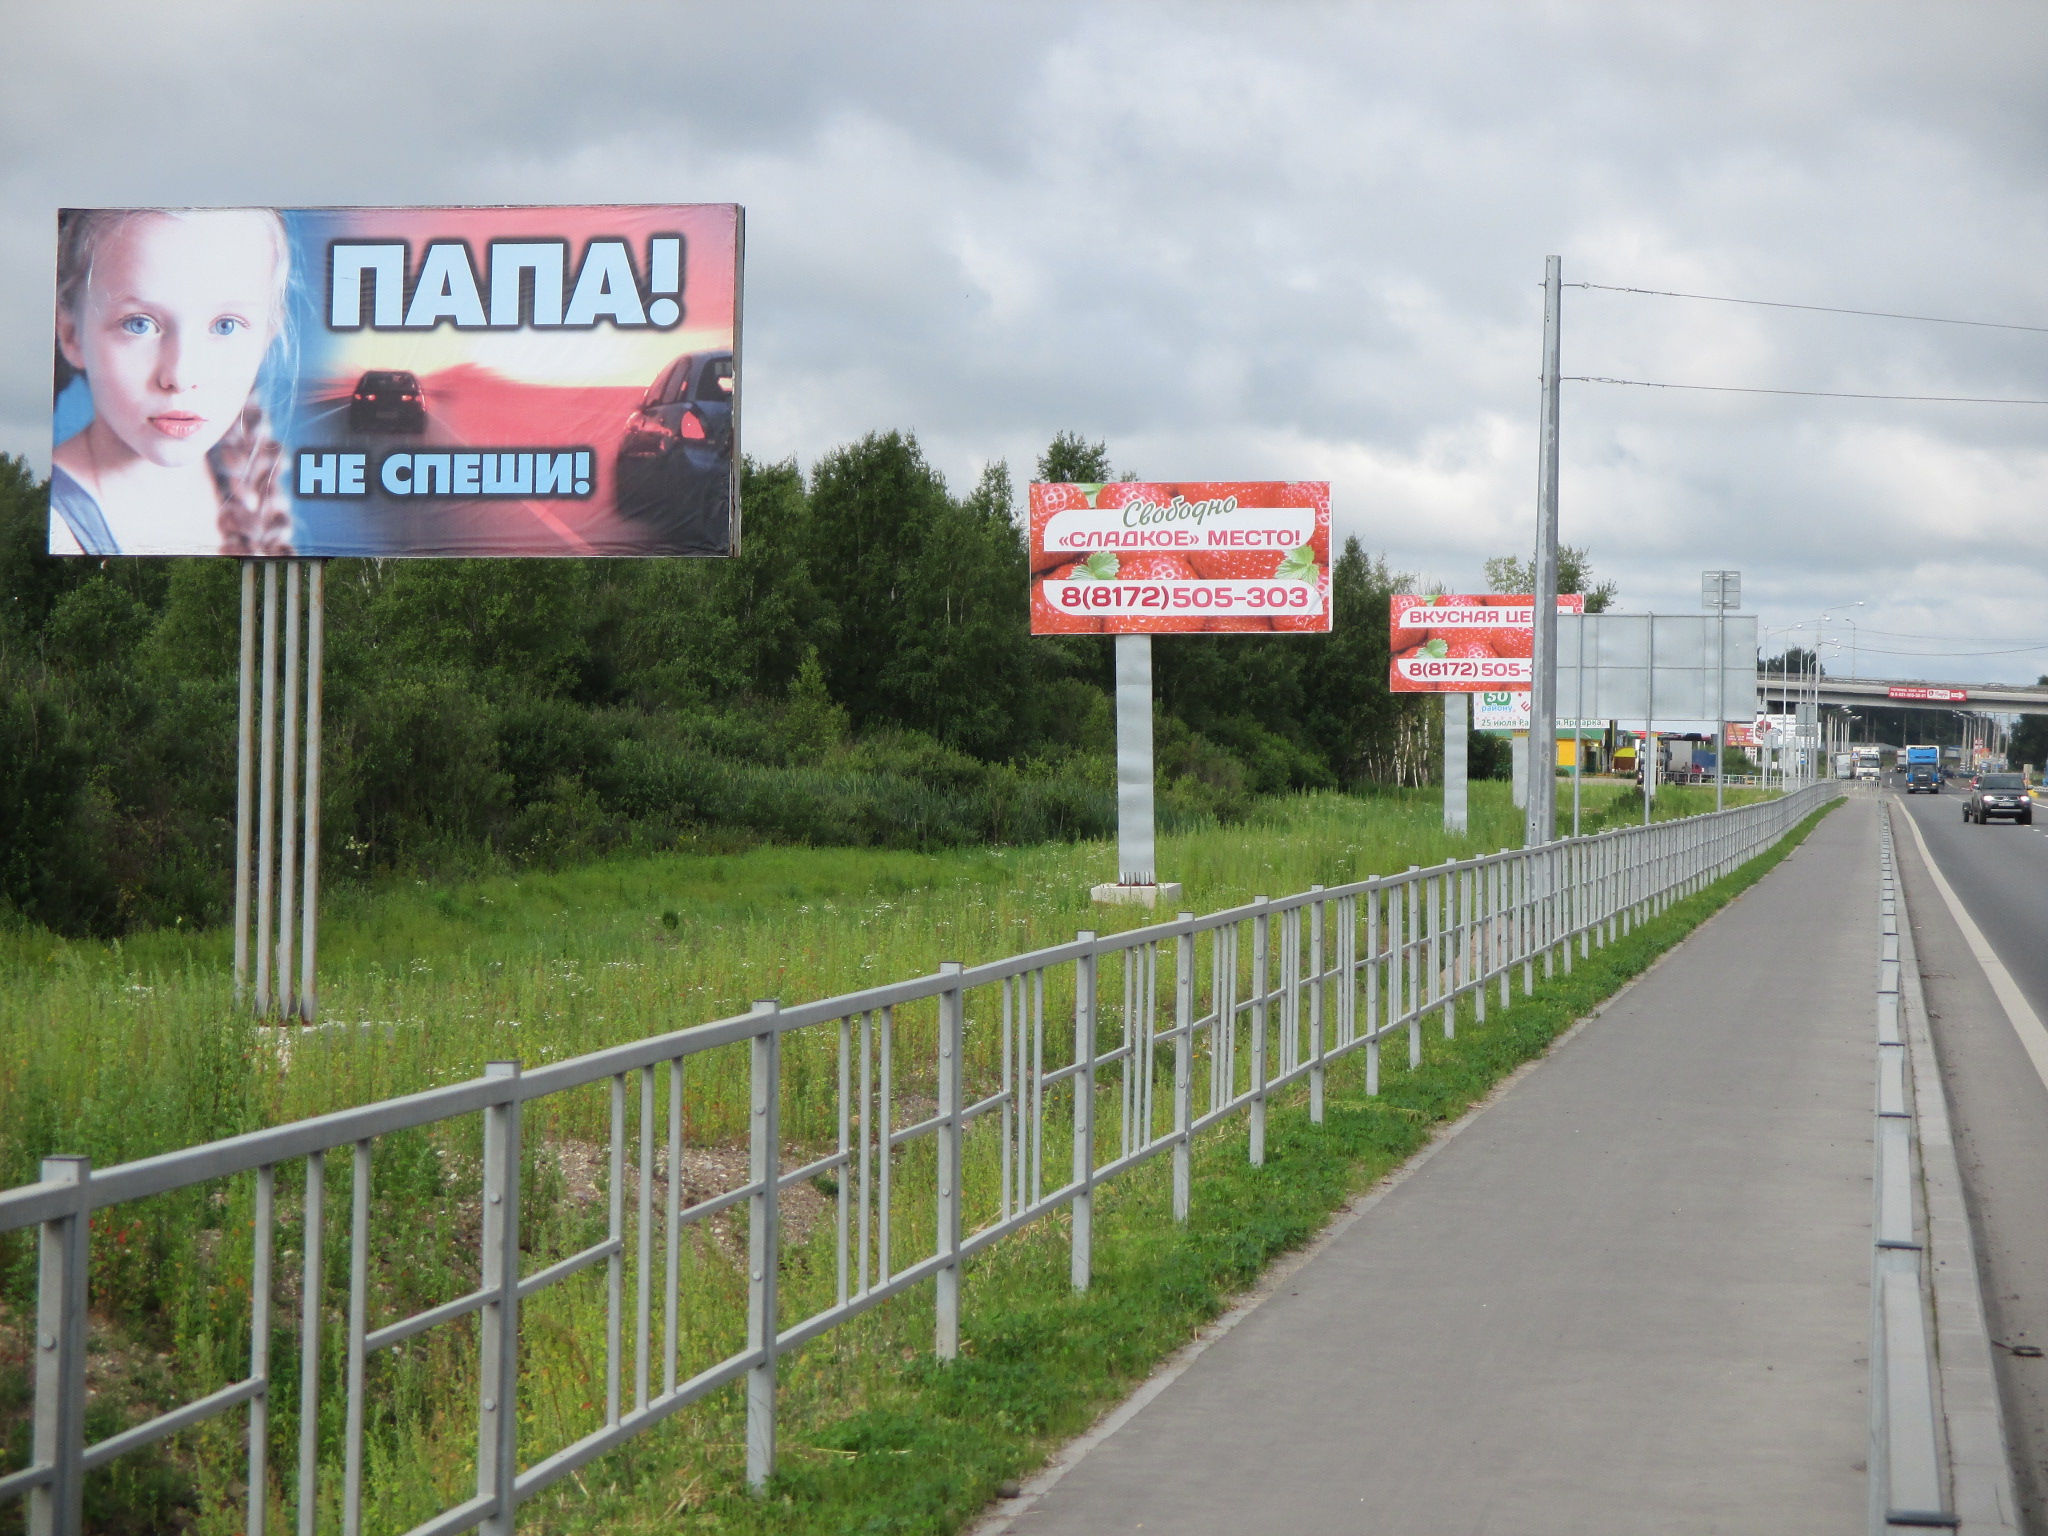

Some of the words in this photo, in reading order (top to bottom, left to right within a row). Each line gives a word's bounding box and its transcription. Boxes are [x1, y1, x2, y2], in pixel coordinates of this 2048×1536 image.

[332, 238, 681, 326] ПАПА!
[299, 453, 366, 494] НЕ
[382, 452, 591, 495] СПЕШИ!
[1122, 495, 1238, 527] Свободно
[1058, 530, 1200, 547] «СЛАДКОЕ»
[1207, 529, 1301, 546] МЕСТО!
[1061, 586, 1309, 610] 8(8172)505-303
[1409, 610, 1499, 623] ВКУСНАЯ
[1481, 703, 1513, 713] району
[1481, 719, 1491, 727] 25
[1494, 719, 1517, 727] июля
